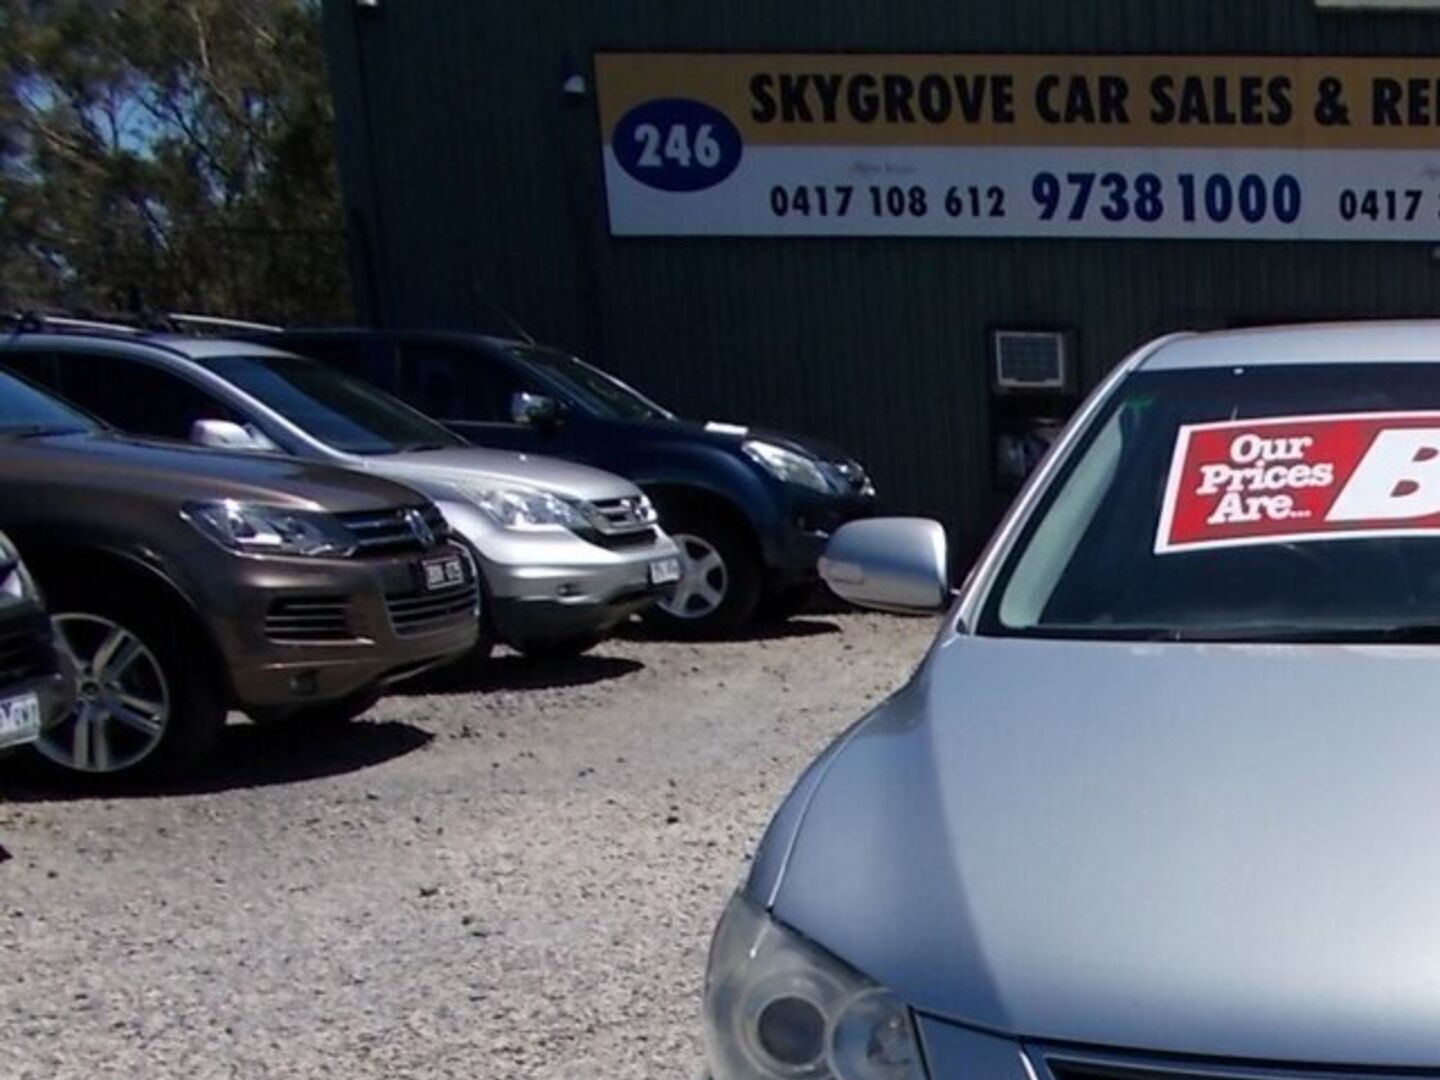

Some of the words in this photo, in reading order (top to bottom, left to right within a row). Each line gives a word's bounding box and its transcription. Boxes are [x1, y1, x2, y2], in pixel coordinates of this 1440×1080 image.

[750, 73, 1015, 124] SKYGROVE
[1035, 76, 1130, 125] CAR
[1149, 76, 1293, 125] SALES
[1315, 78, 1350, 126] &
[634, 124, 721, 167] 246
[770, 186, 853, 216] 0417
[870, 187, 928, 217] 108
[944, 187, 1005, 217] 612
[1339, 190, 1422, 221] 0417
[1230, 434, 1313, 463] Our
[1196, 459, 1334, 495] Prices
[1206, 492, 1312, 525] Are...
